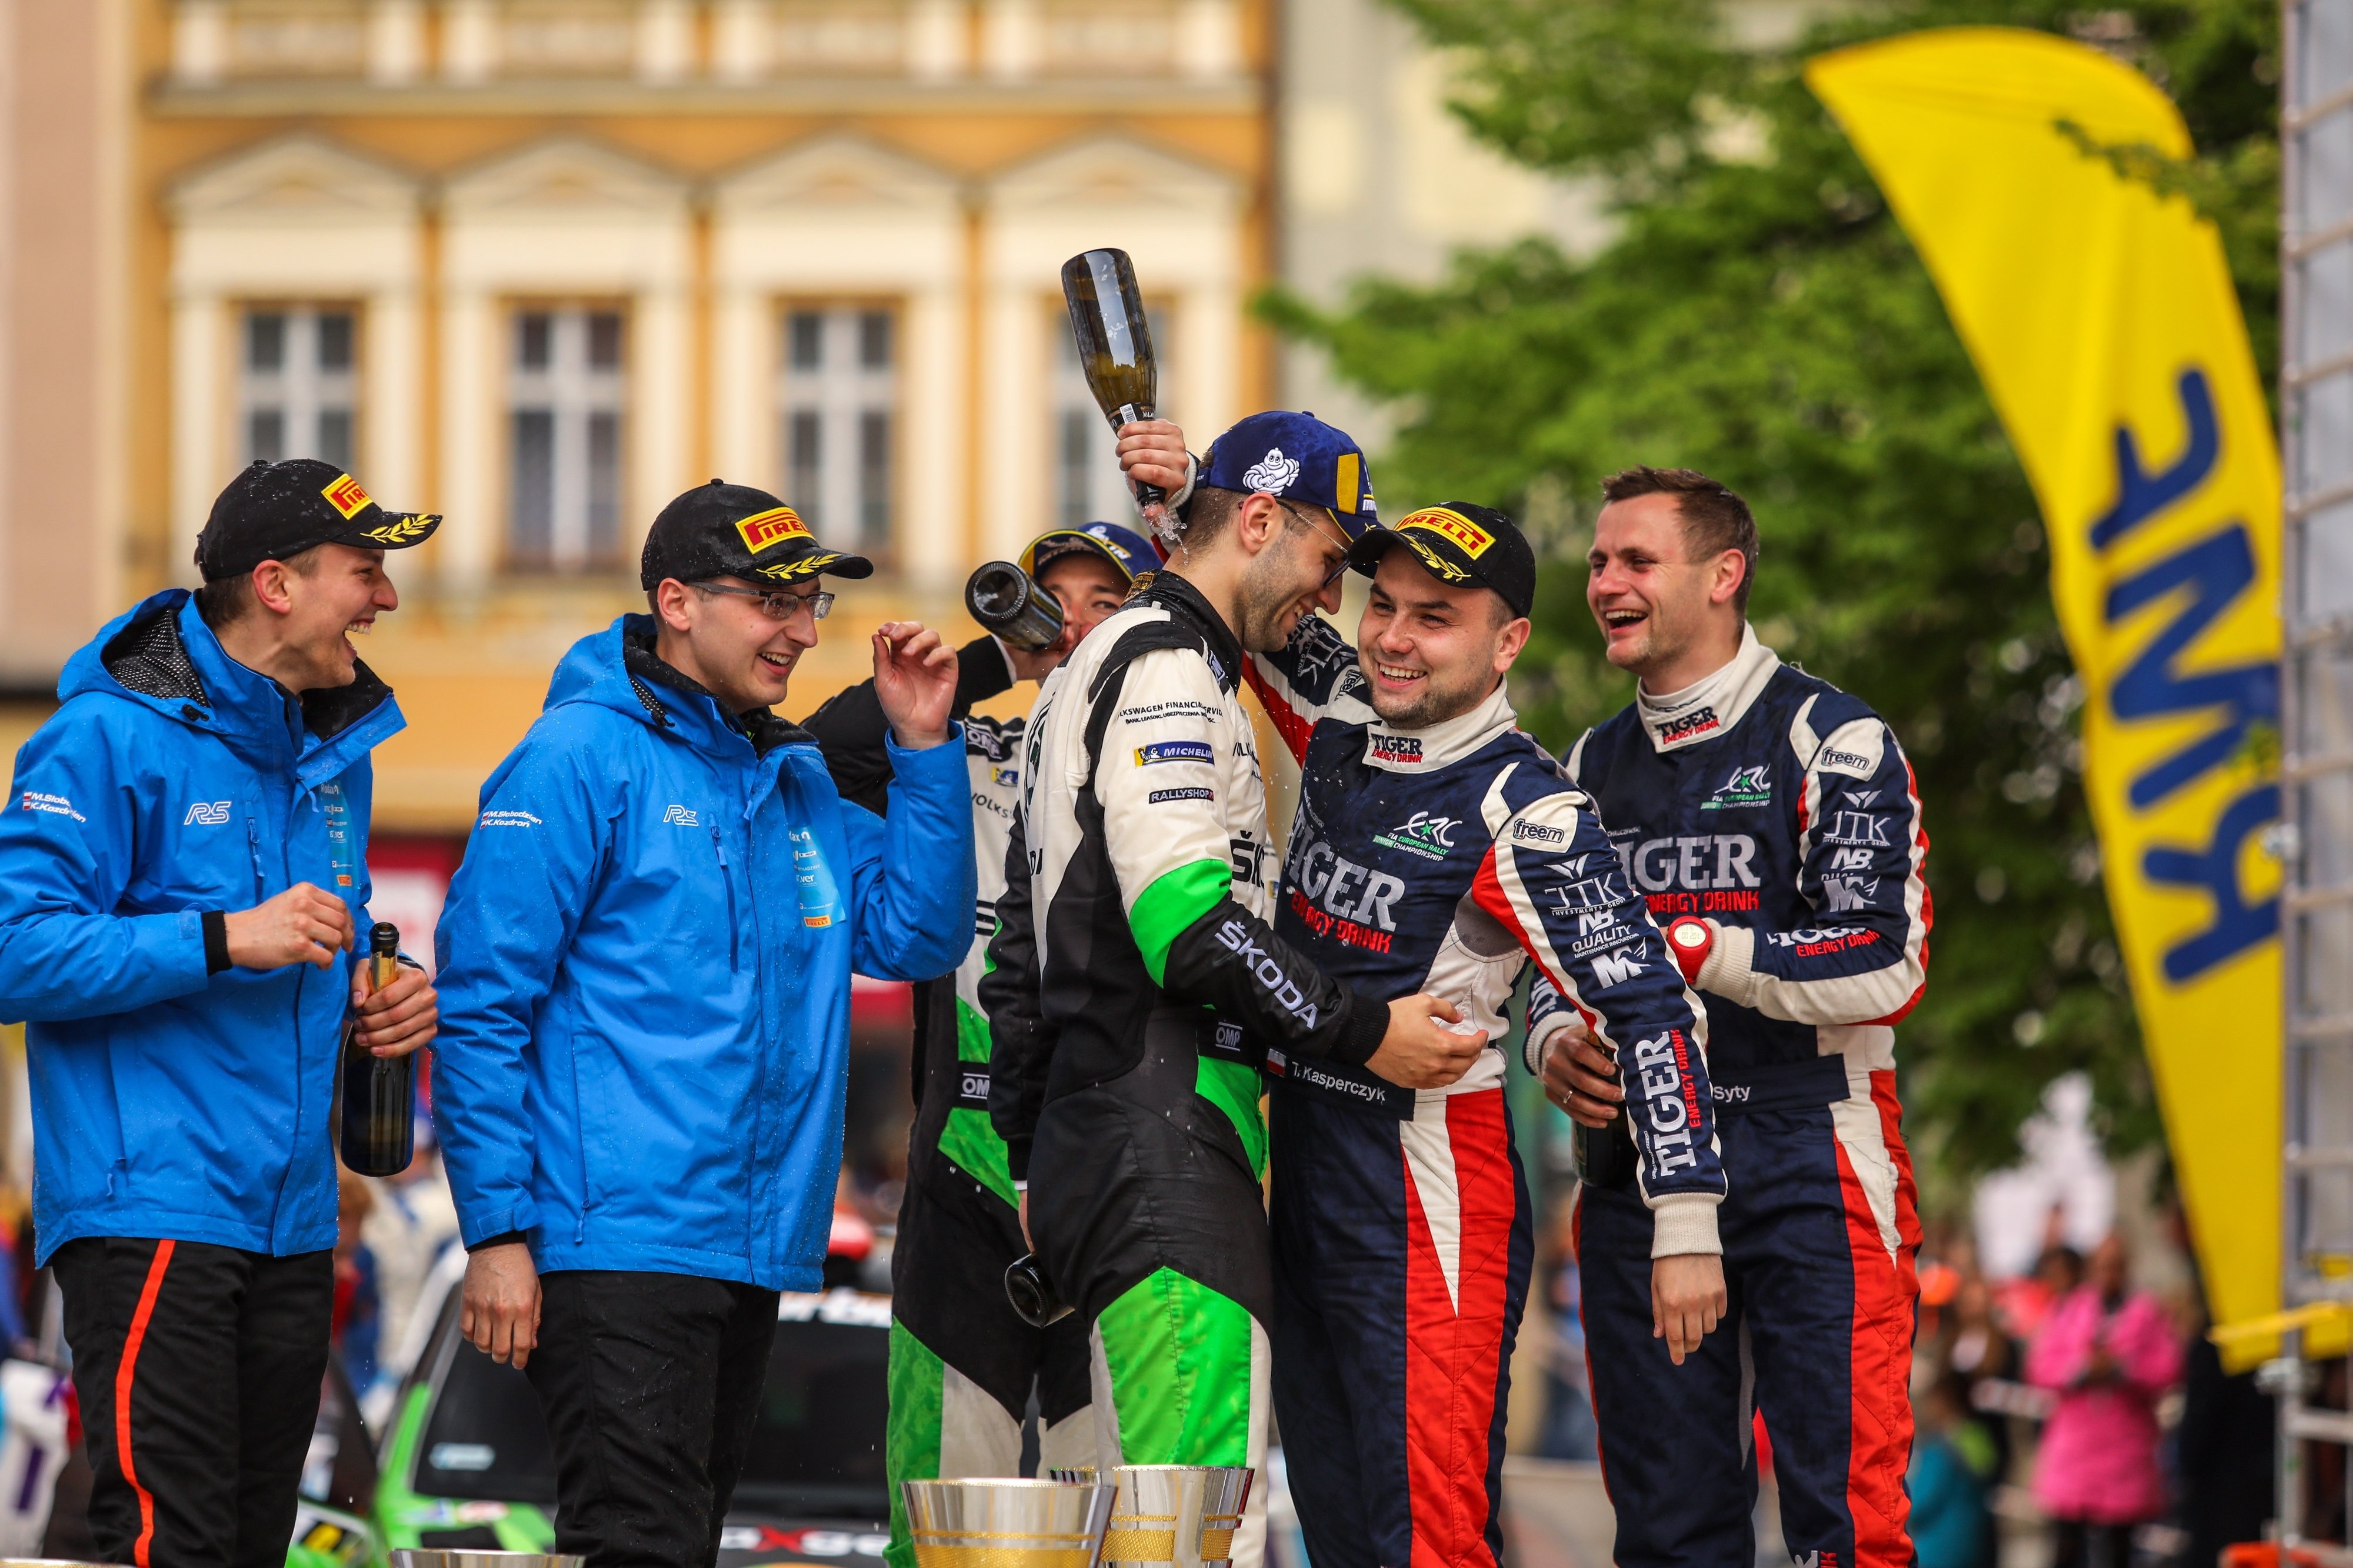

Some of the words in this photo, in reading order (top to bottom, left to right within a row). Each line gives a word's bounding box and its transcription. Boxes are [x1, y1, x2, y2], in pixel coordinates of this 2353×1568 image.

[744, 512, 810, 546] PIREL
[1654, 706, 1718, 738] TIGER
[1371, 733, 1424, 755] TIGER
[1663, 728, 1693, 745] ENERGY
[1371, 748, 1397, 762] ENERGY
[1397, 753, 1424, 763] DRINK
[1822, 748, 1869, 770] freem
[1514, 819, 1564, 842] freem
[1823, 810, 1891, 841] JTK
[1387, 832, 1398, 841] FIA
[1398, 836, 1429, 850] EUROPEAN
[1428, 845, 1449, 856] RALLY
[1393, 842, 1444, 862] CHAMPIONSHIP
[1284, 801, 1406, 932] TIGER
[1617, 834, 1761, 892] IGER
[1544, 872, 1624, 910] JTK
[1644, 892, 1702, 914] ENERGY
[1704, 890, 1760, 912] DRINK
[1552, 905, 1603, 916] INVESTMENTS
[1335, 919, 1394, 955] DRINK
[1572, 925, 1631, 953] QUALITY
[1574, 943, 1609, 959] MAINTENANCE
[1608, 933, 1639, 948] INNOVATIONS
[1796, 938, 1846, 958] ENERGY
[1214, 921, 1319, 1030] ŠKODA
[1216, 1026, 1241, 1047] OMP
[1671, 1029, 1689, 1070] DRINK
[962, 1077, 989, 1096] OM
[1302, 1066, 1385, 1102] Kasperczyk
[1714, 1085, 1751, 1103] Syty
[1635, 1031, 1697, 1177] TIGER
[1680, 1073, 1701, 1129] ENERGY
